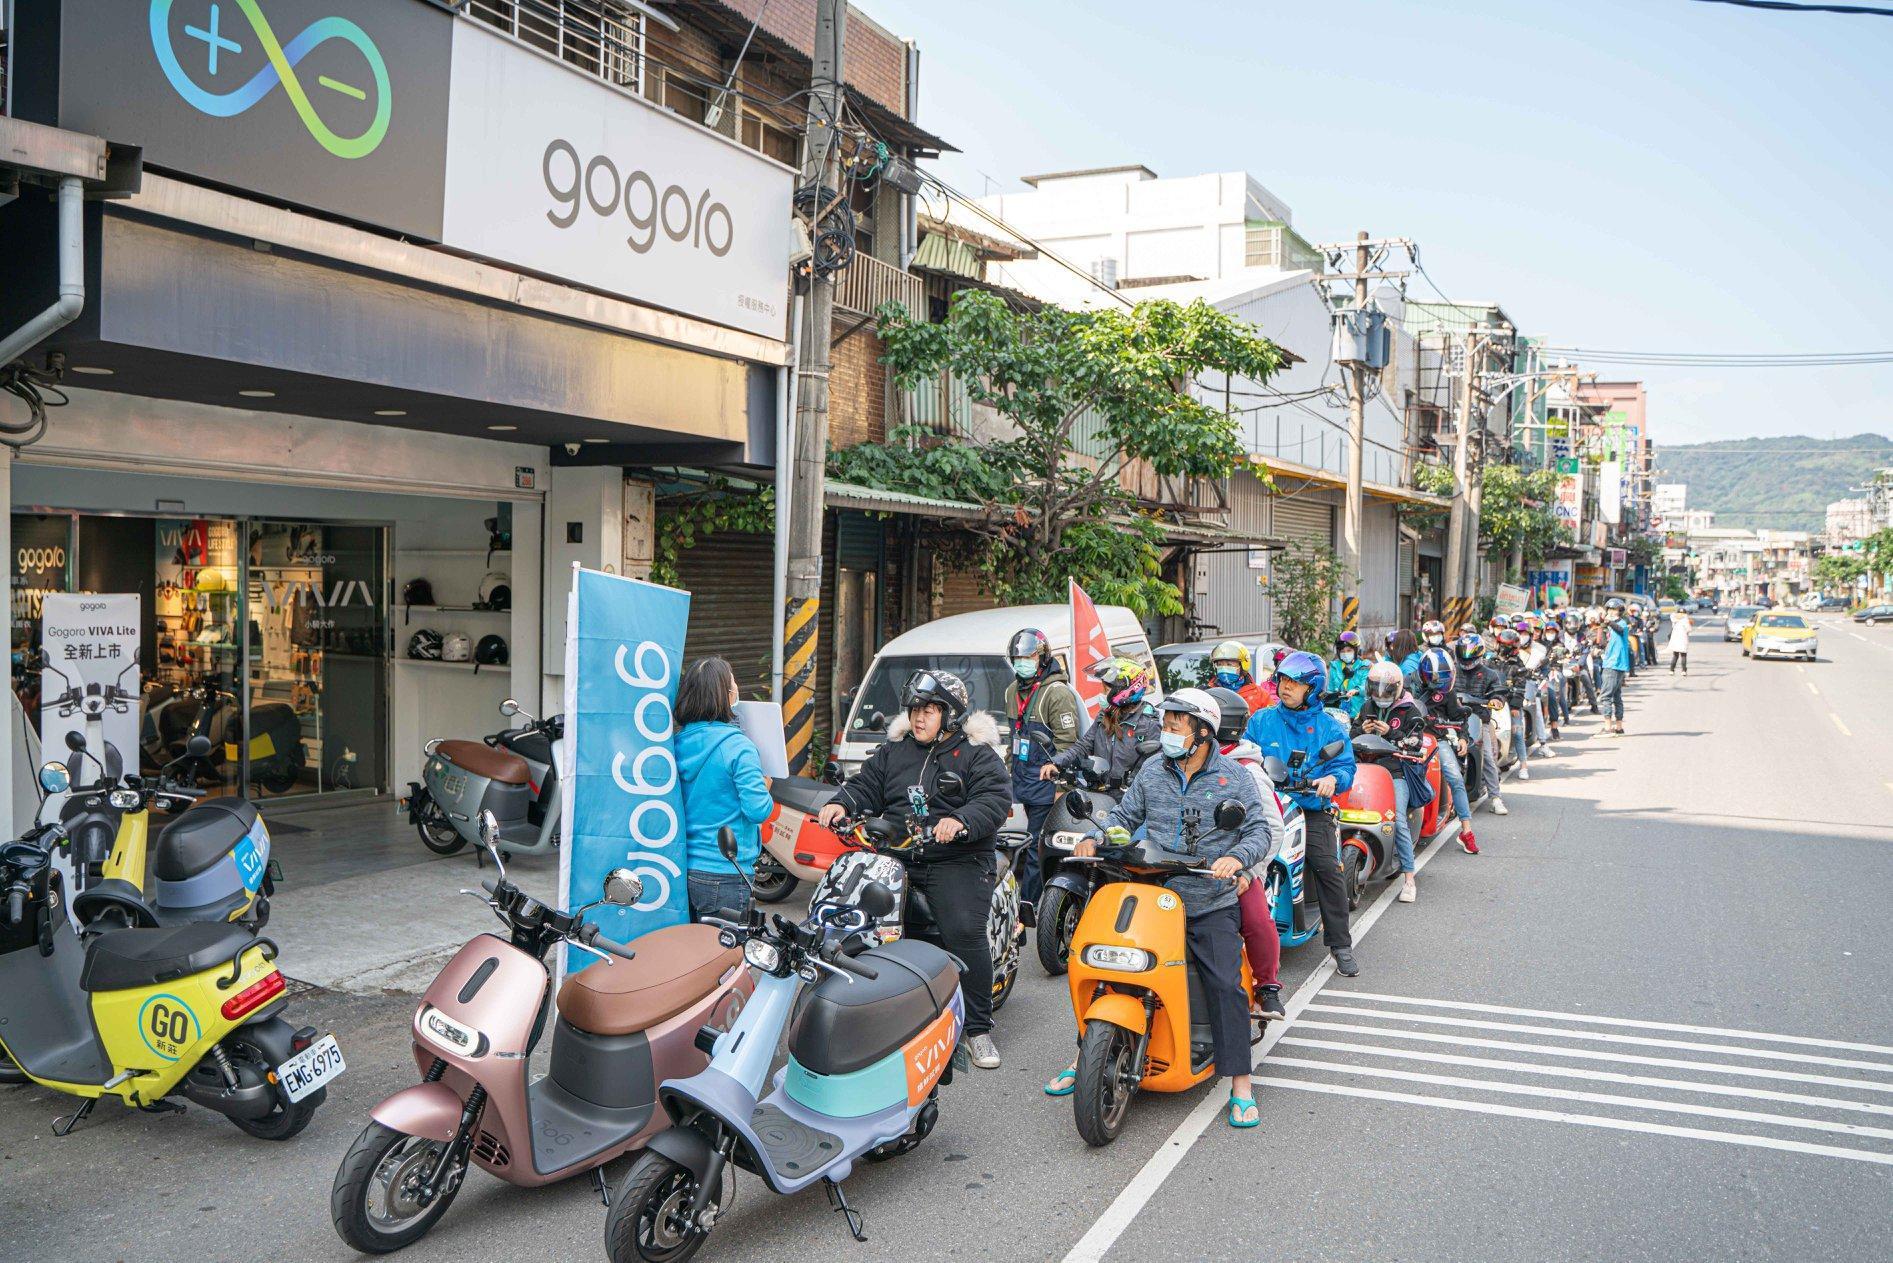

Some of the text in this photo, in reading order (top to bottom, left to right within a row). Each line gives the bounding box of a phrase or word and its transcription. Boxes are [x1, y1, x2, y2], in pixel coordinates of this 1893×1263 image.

[542, 138, 734, 258] gogoro
[1555, 506, 1578, 516] CNC
[18, 546, 66, 574] gogoro
[79, 602, 107, 612] gogoro
[262, 580, 374, 607] VIVA
[48, 625, 137, 639] Gogoro VIVA Lite
[64, 643, 122, 661] 全新上市
[612, 640, 682, 912] gogoro
[151, 1003, 188, 1045] GO
[915, 1014, 962, 1075] VIVA
